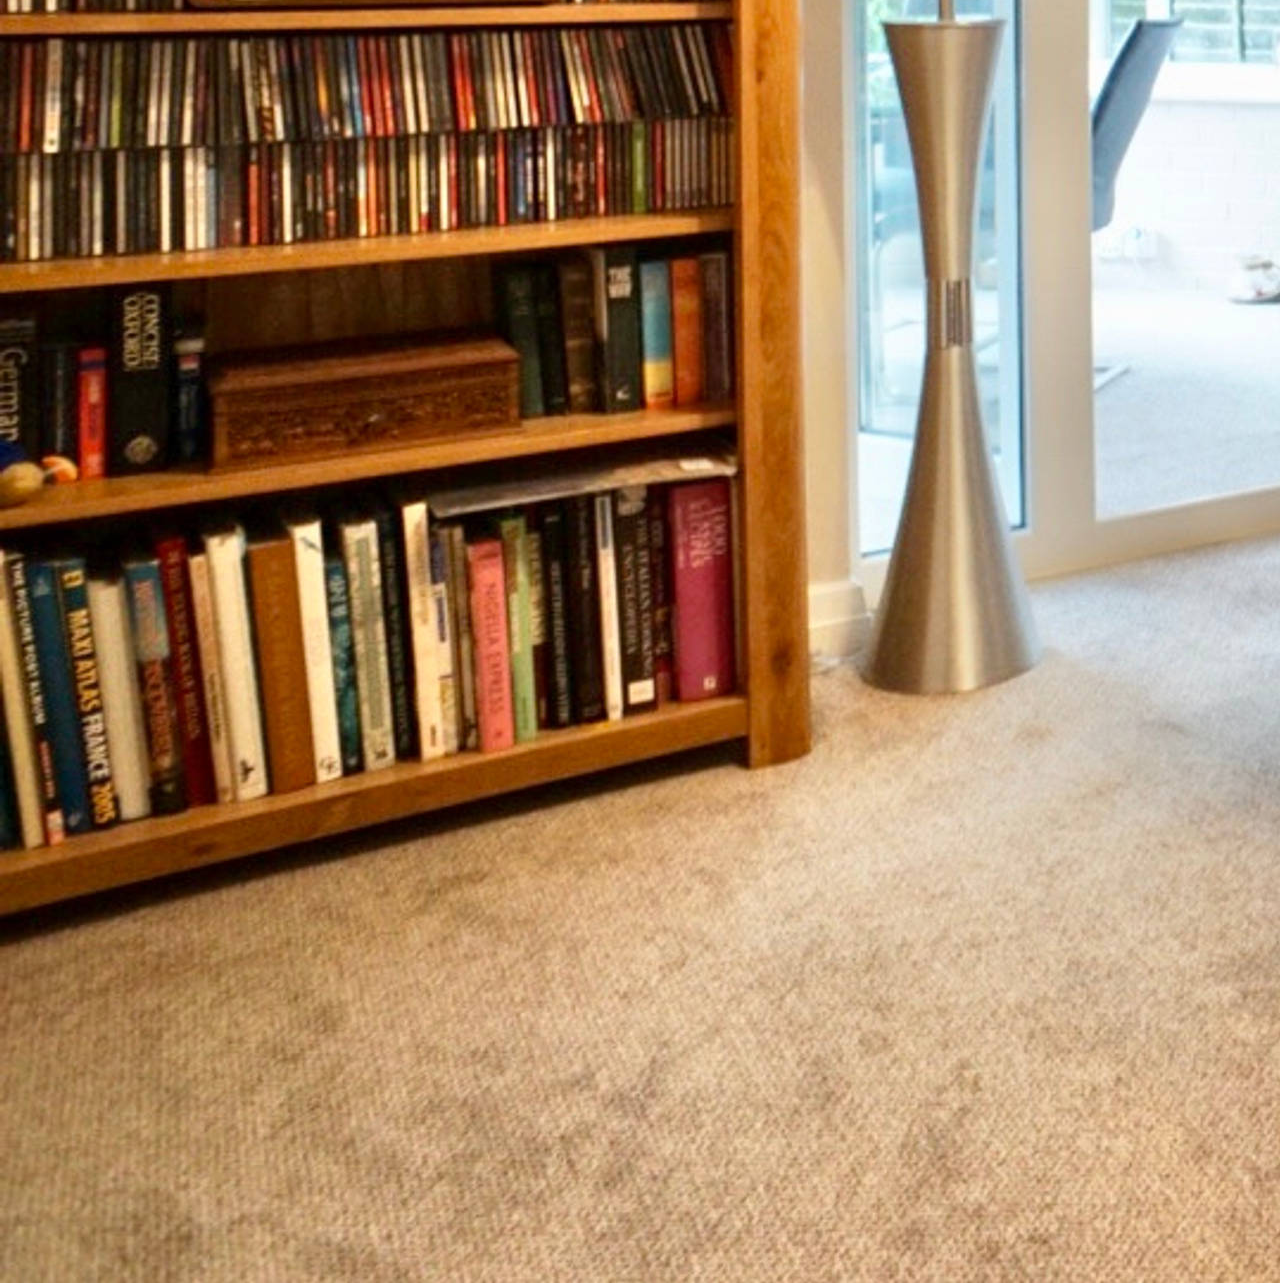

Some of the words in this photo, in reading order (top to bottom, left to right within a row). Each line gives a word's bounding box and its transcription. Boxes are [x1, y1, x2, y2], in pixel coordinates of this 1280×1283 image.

[123, 296, 141, 371] OXFORD
[142, 295, 160, 369] CONCISE
[10, 562, 26, 586] THE
[638, 552, 651, 608] ITALIAN
[14, 588, 35, 642] PICTURE
[67, 609, 93, 656] MAXI
[482, 582, 501, 646] NIGELLA
[23, 645, 41, 679] POST
[641, 613, 655, 679] COOKING
[74, 658, 101, 712] ATLAS
[487, 651, 506, 715] EXPRESS
[81, 712, 110, 780] FRANCE
[91, 781, 116, 823] 2005
